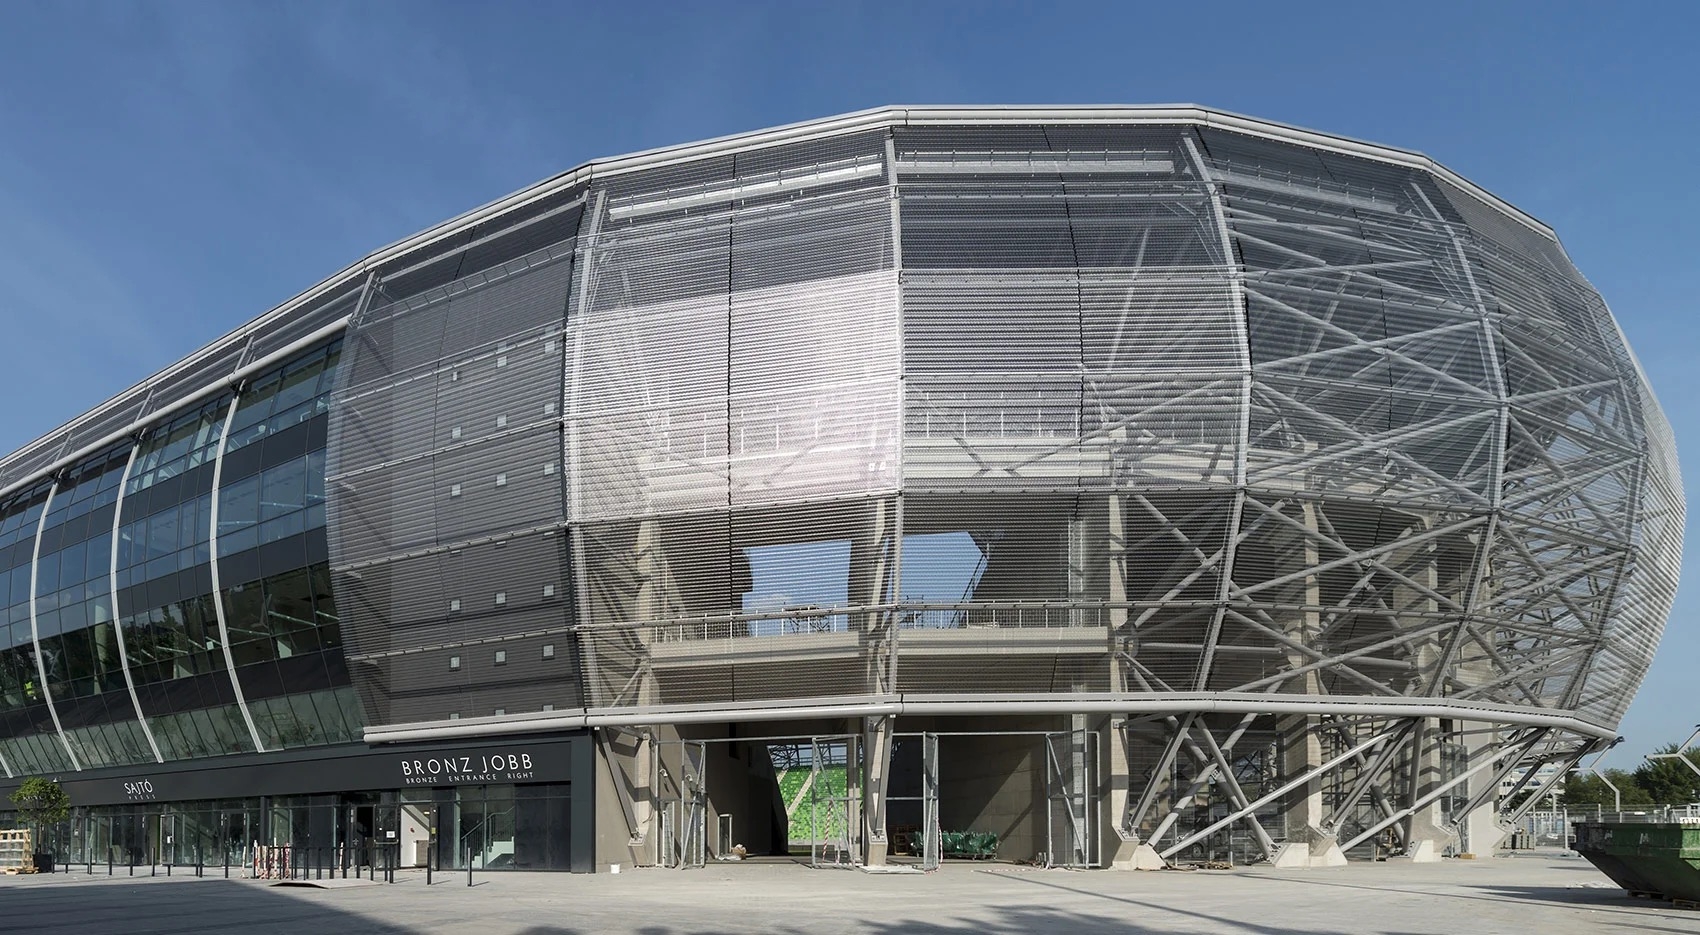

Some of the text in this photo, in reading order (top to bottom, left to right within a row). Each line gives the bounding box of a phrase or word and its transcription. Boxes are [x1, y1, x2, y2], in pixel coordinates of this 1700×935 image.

[401, 753, 533, 776] BRONZ JOBB
[124, 778, 153, 795] SAJTÓ
[405, 771, 534, 785] BRONZE ENTRANCE RIGHT
